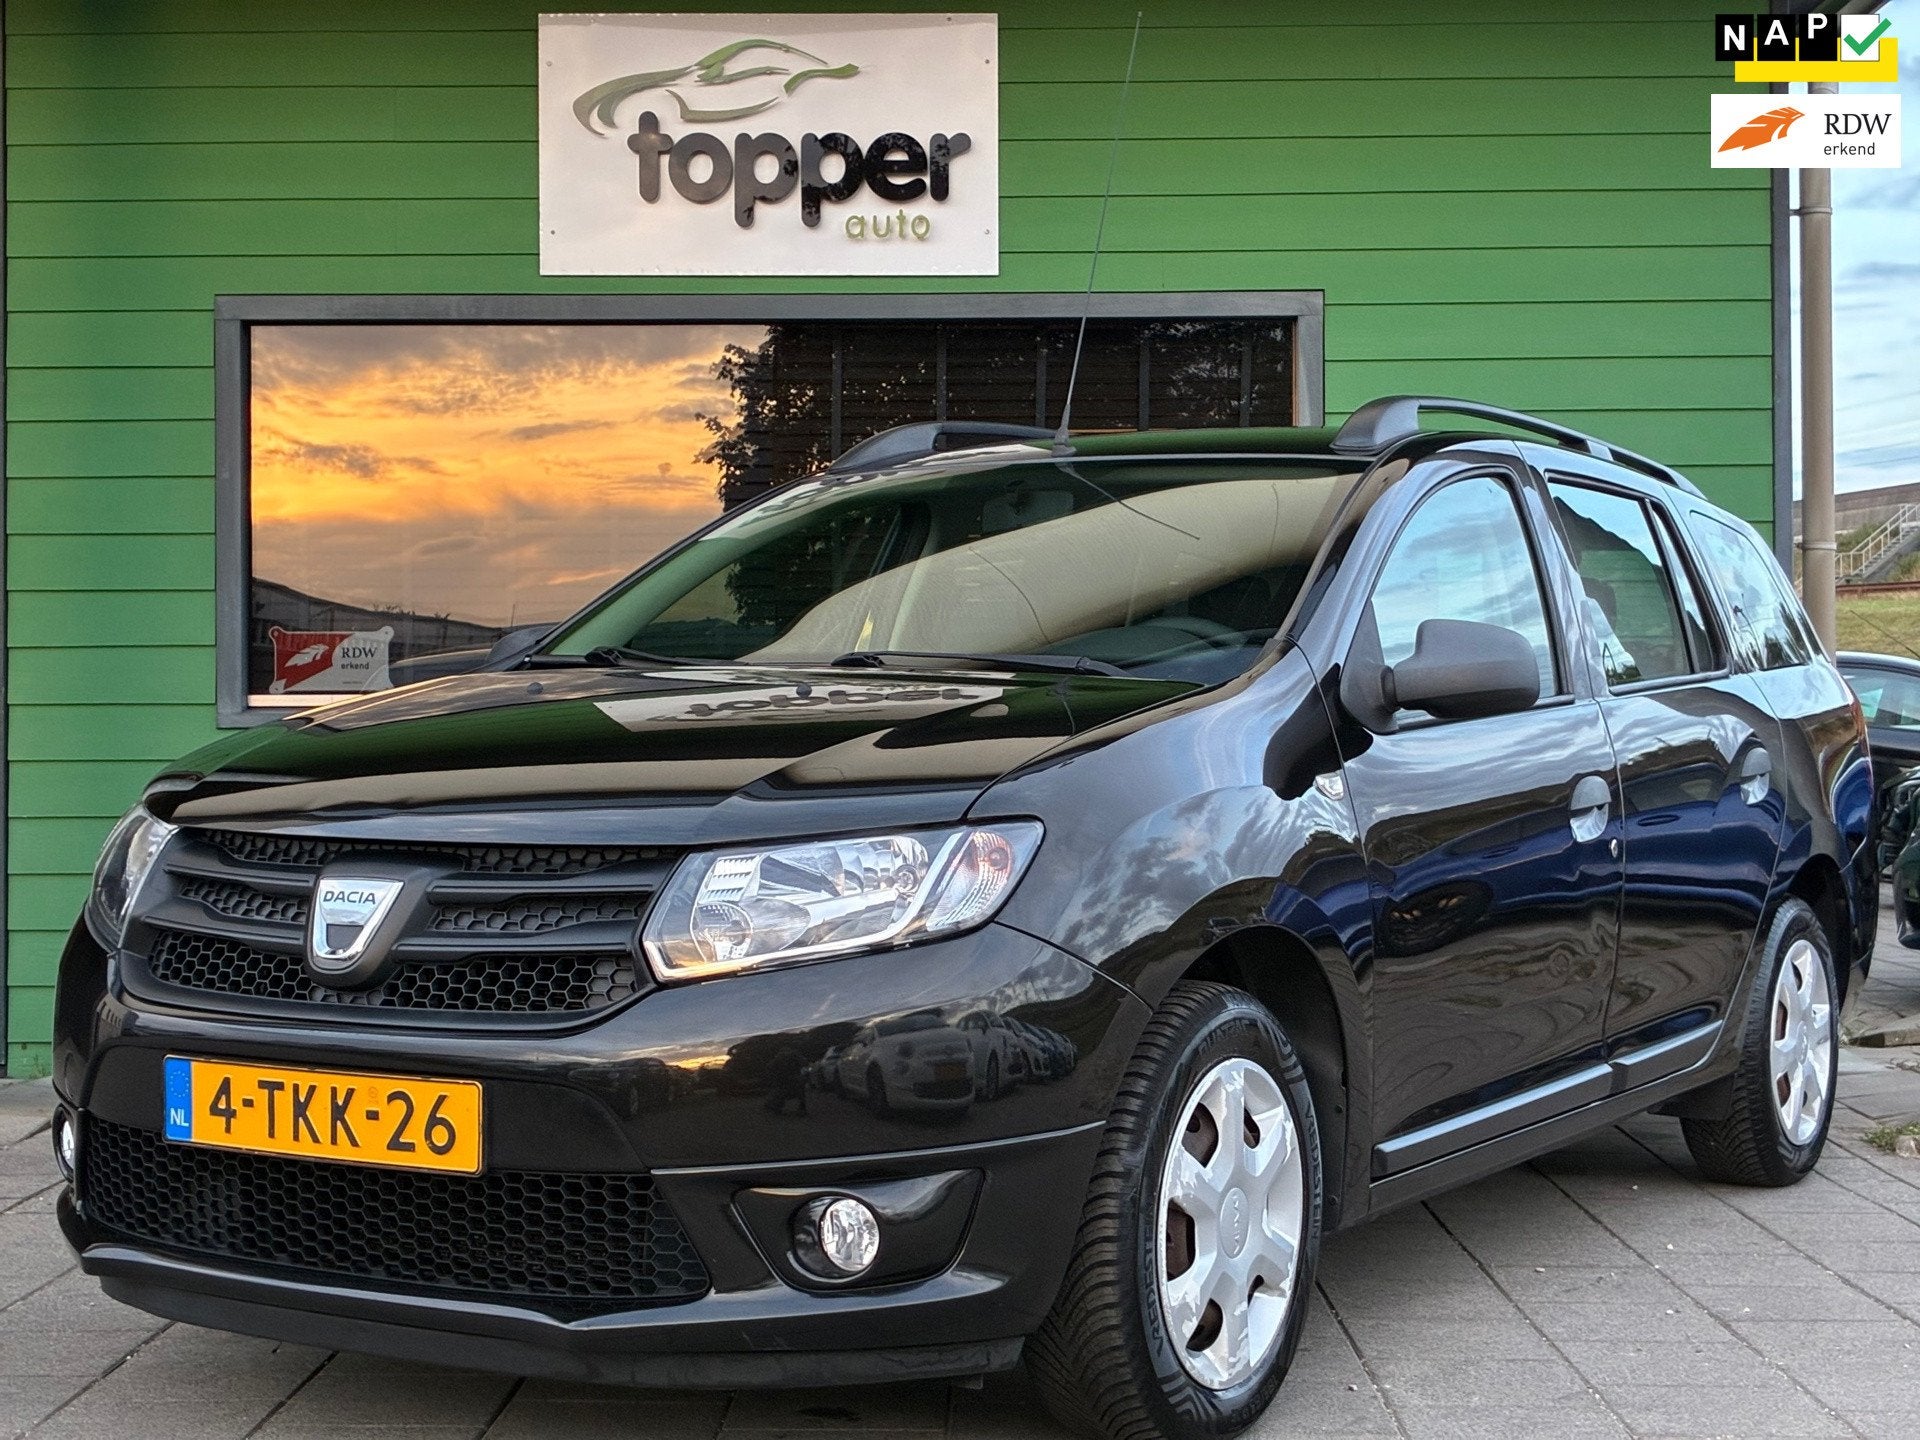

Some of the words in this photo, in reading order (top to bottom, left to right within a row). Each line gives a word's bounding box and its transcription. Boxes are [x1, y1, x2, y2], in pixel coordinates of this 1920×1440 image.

[627, 111, 972, 227] topper
[845, 209, 931, 240] auto
[342, 647, 377, 658] RDW
[341, 661, 370, 670] erkend
[323, 890, 377, 905] DACIA
[170, 1108, 189, 1127] NL
[209, 1076, 456, 1156] 4-TKK-26
